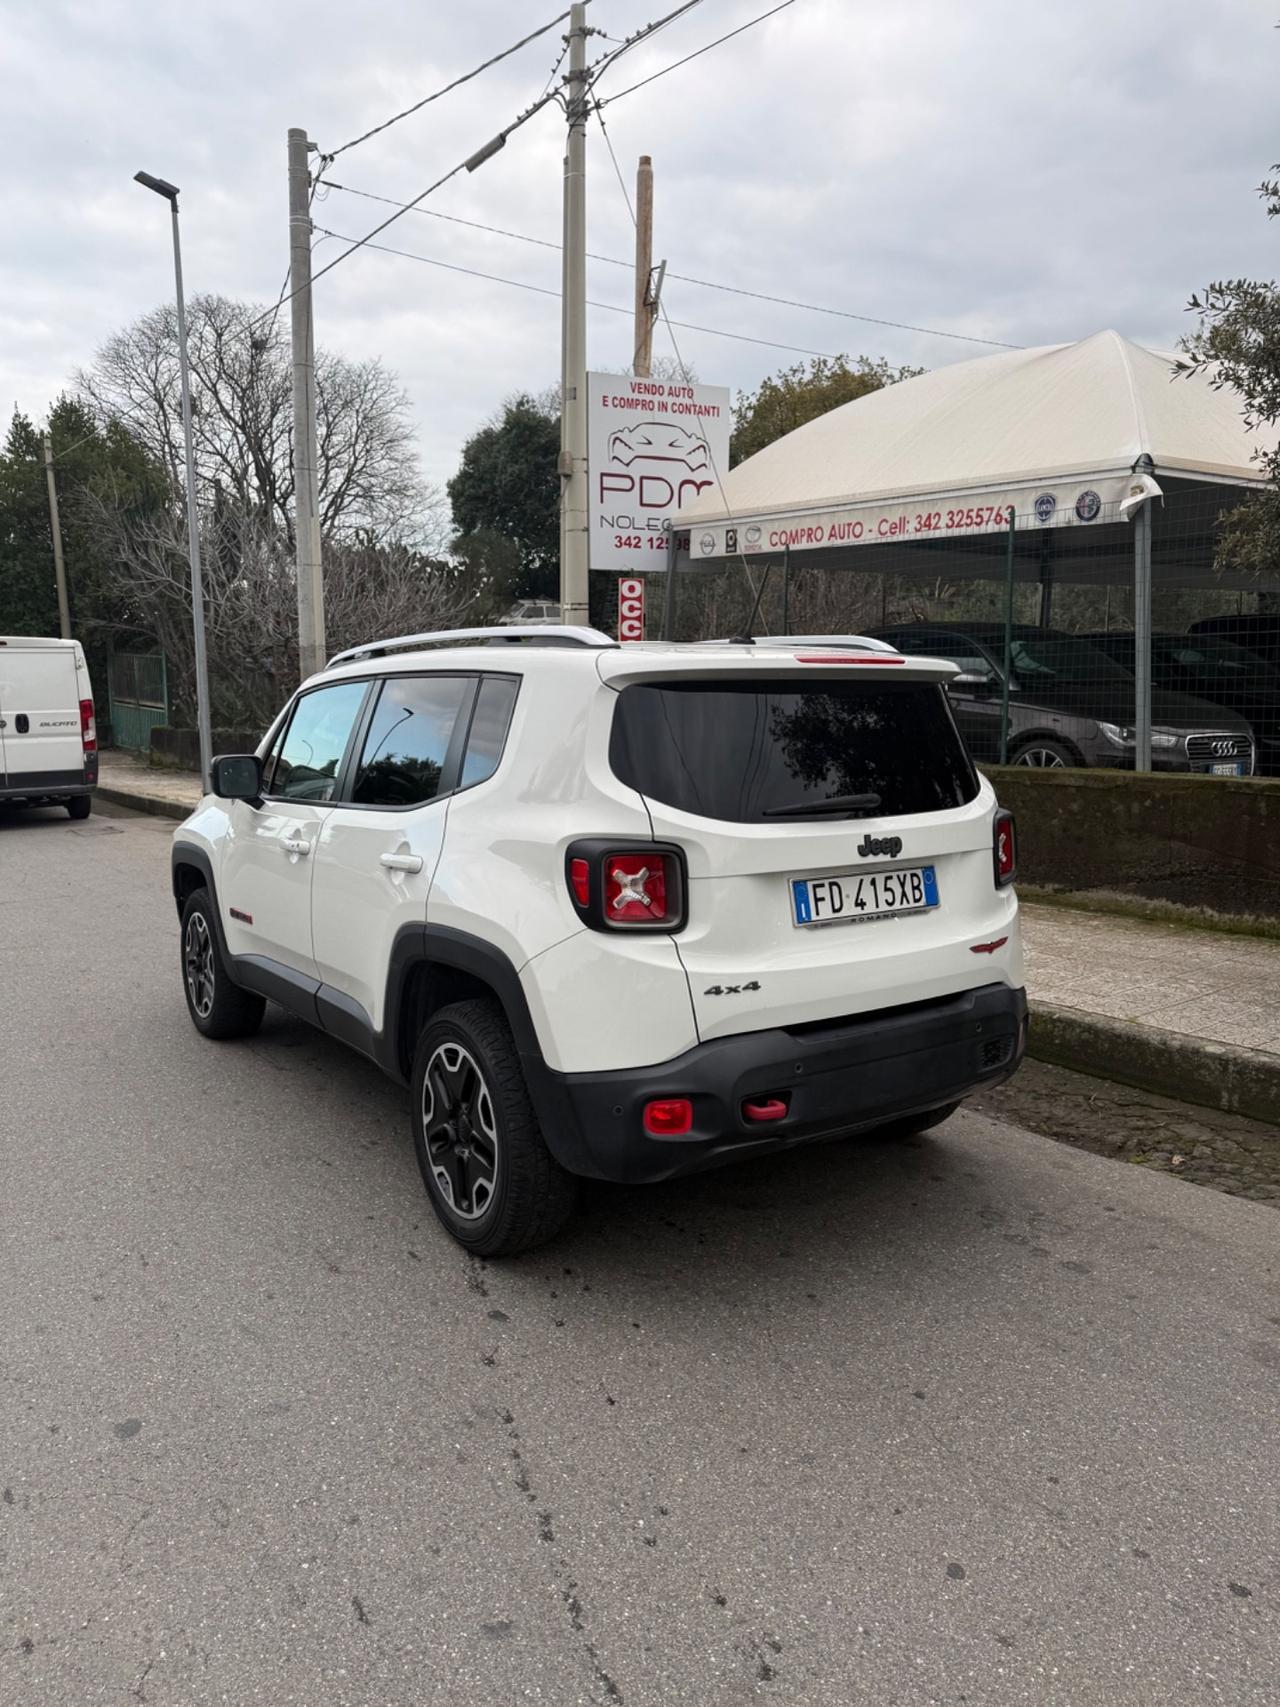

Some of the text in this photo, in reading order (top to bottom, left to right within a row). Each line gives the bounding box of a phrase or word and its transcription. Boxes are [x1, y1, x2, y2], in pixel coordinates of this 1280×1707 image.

[630, 382, 694, 399] VENDO AUTO
[602, 392, 720, 417] E COMPRO IN CONTANTI
[769, 526, 824, 547] COMPRO
[828, 521, 864, 541] AUTO
[878, 517, 910, 536] Cell:
[914, 511, 941, 533] 342
[945, 505, 1014, 529] 3255763
[614, 535, 642, 549] 342
[857, 834, 903, 858] Jeep
[812, 881, 843, 916] FD
[854, 873, 923, 911] 415XB
[850, 912, 898, 923] ROMANO
[703, 981, 762, 996] 4x4
